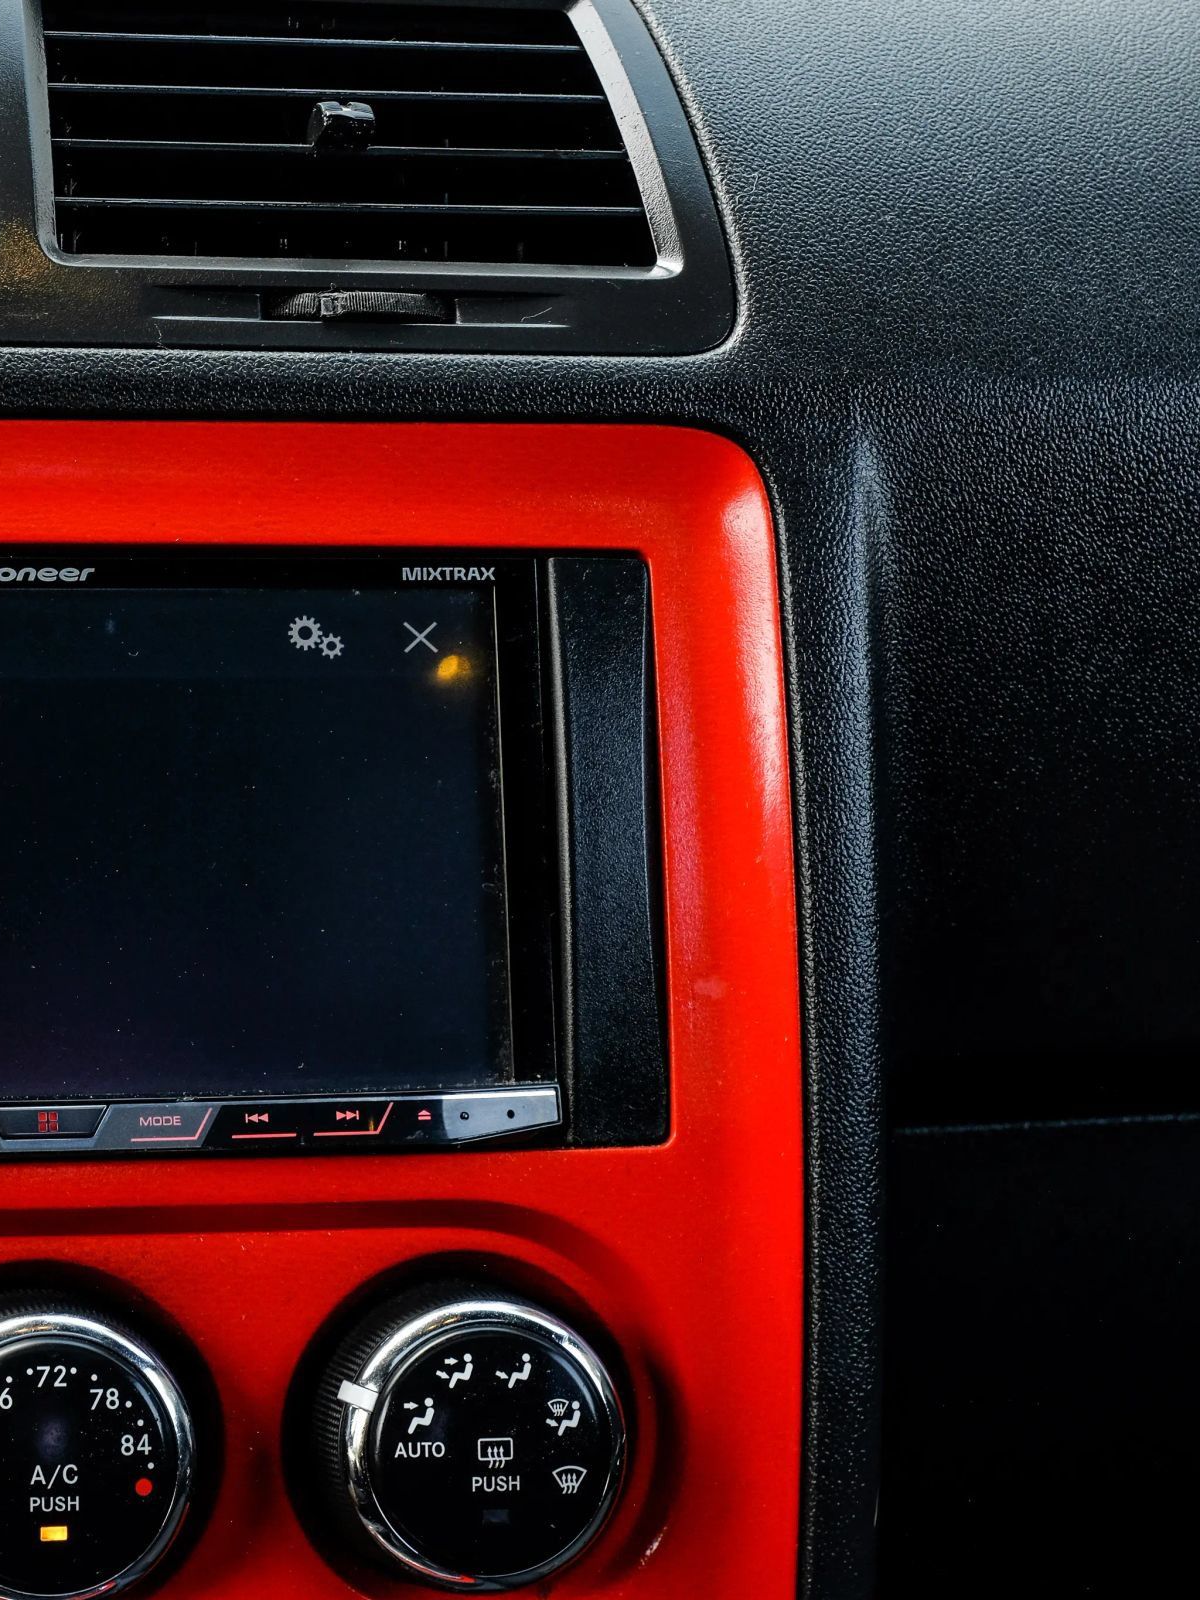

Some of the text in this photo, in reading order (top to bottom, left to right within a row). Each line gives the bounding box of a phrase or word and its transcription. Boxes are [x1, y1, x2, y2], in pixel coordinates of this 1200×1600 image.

[401, 567, 496, 581] MIXTRAX
[139, 1116, 182, 1127] MODE
[36, 1366, 67, 1387] 72
[89, 1388, 120, 1410] 78
[120, 1434, 152, 1456] 84
[394, 1441, 445, 1458] AUTO
[30, 1464, 78, 1489] A/C
[472, 1476, 520, 1492] PUSH
[29, 1496, 80, 1512] PUSH
